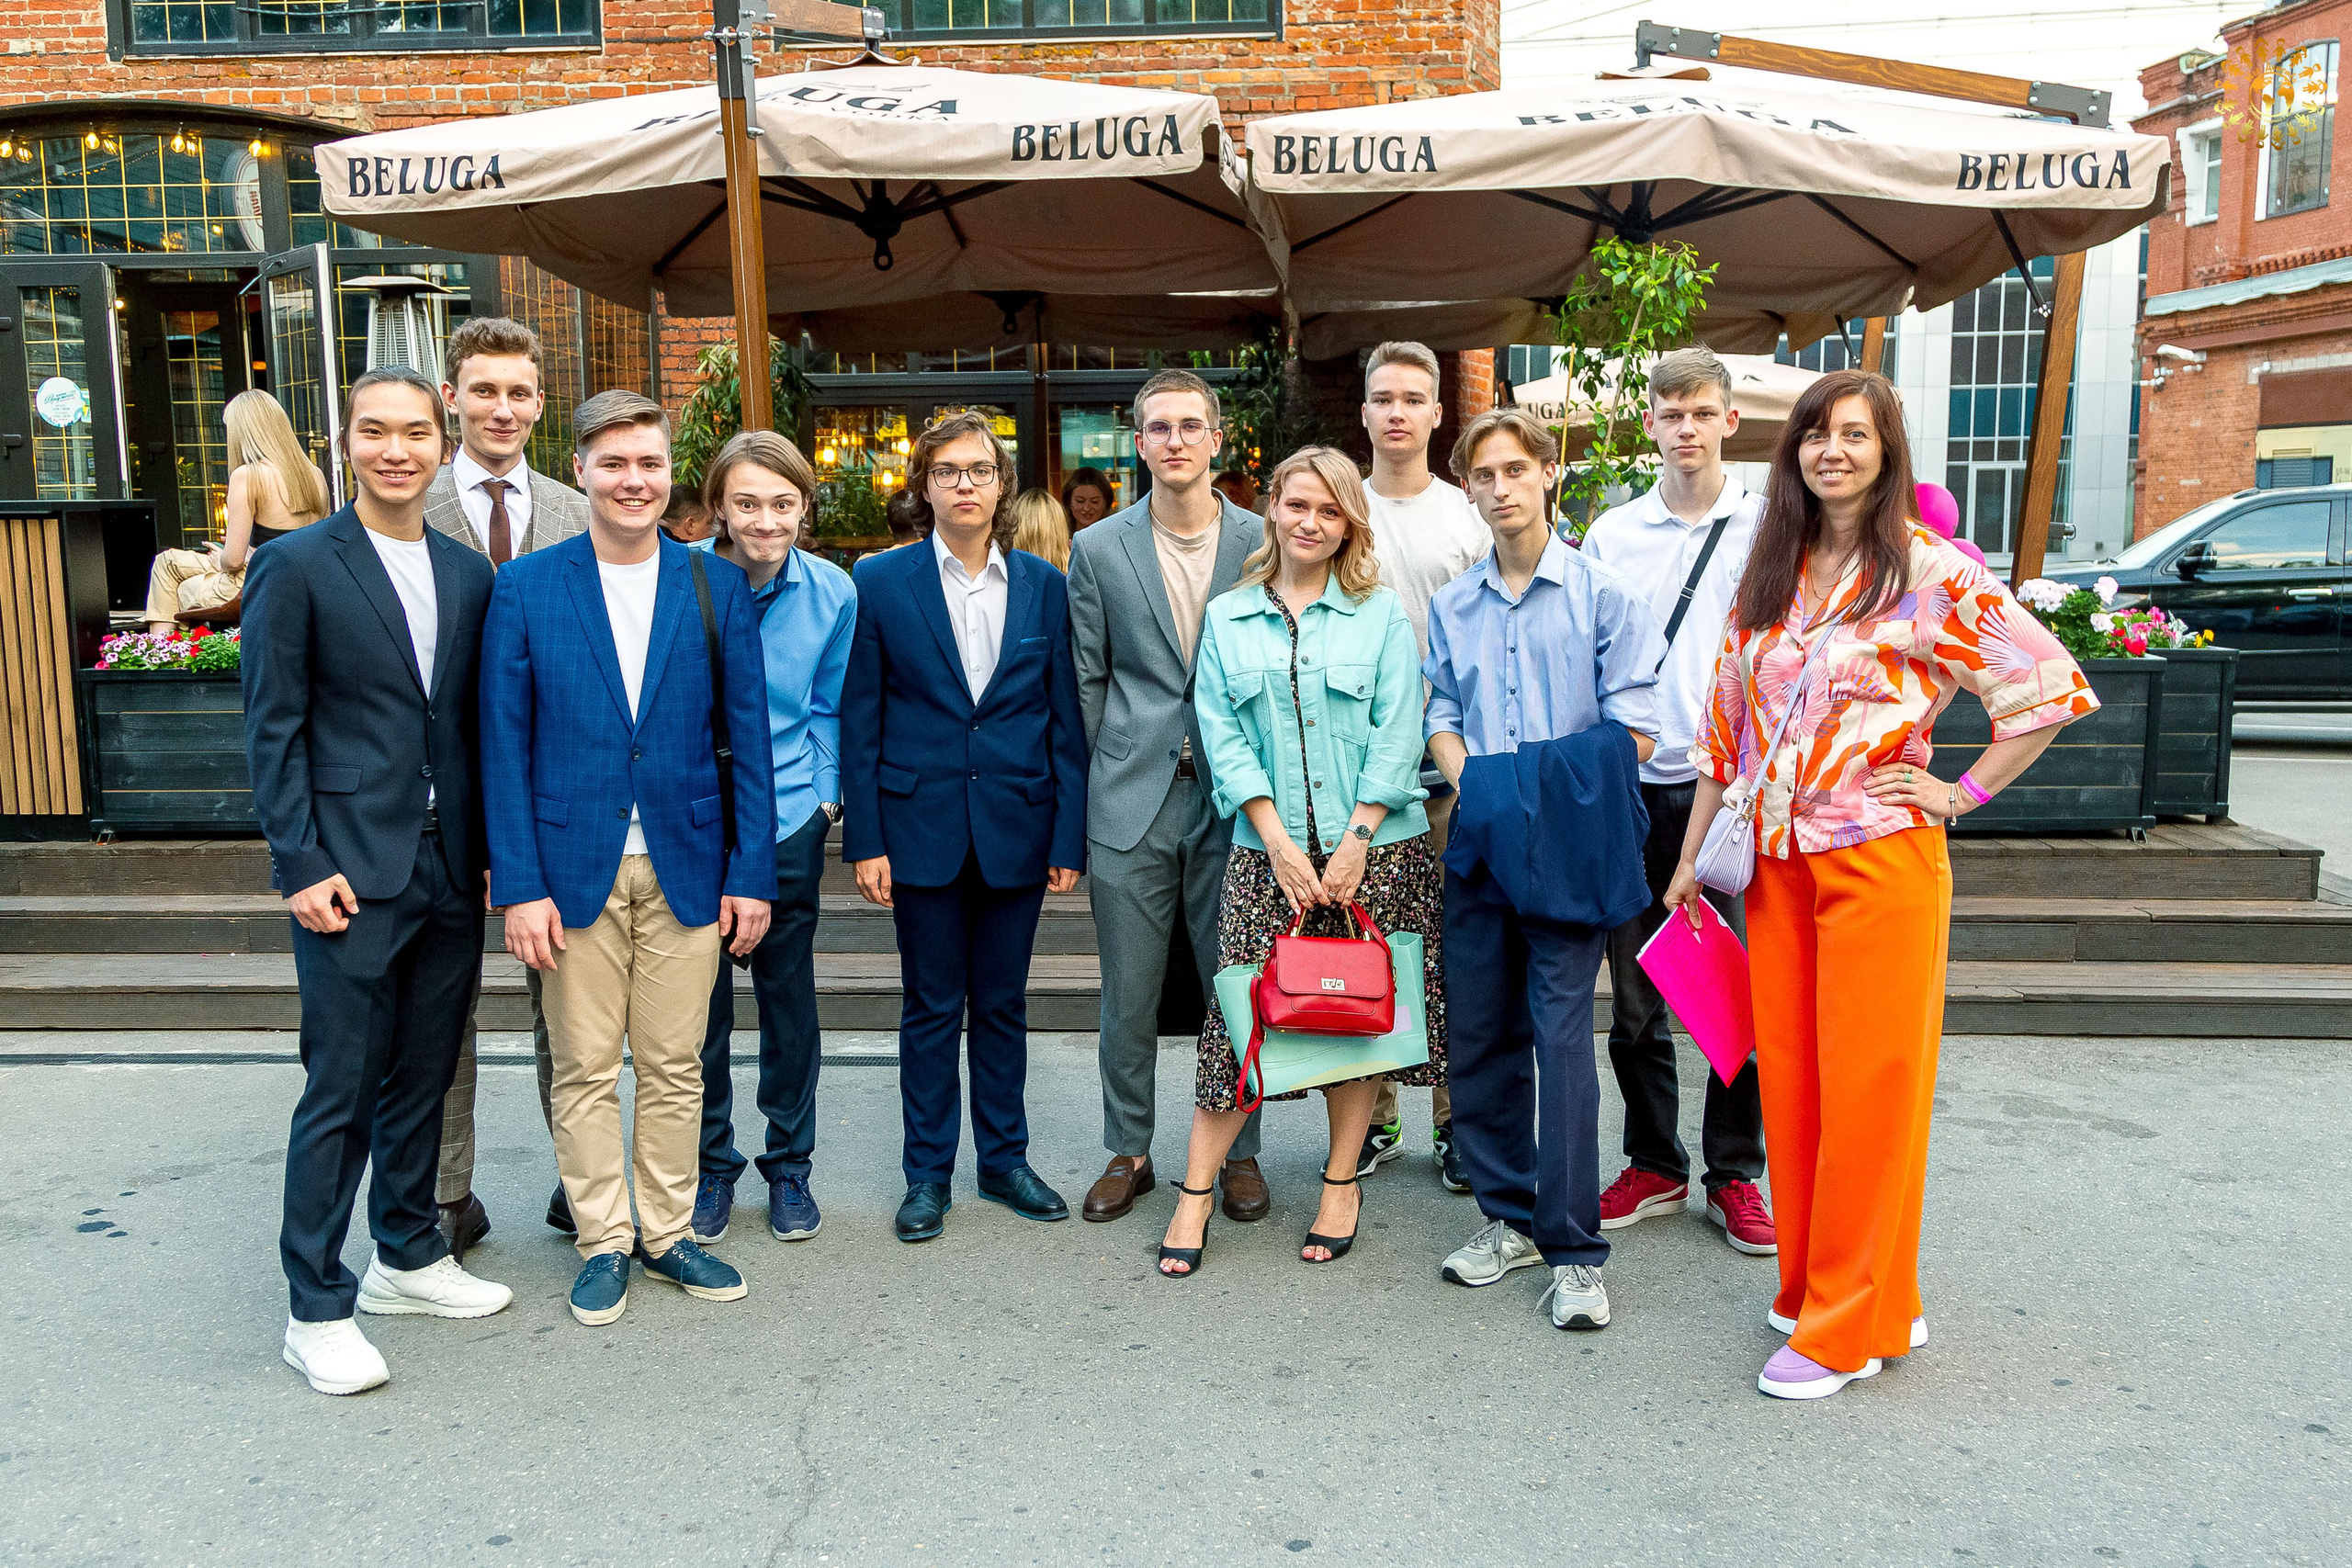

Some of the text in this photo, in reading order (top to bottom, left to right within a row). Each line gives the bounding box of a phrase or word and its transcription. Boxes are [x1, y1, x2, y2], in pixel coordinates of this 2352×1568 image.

[1010, 113, 1184, 162] BELUGA
[1272, 134, 1439, 175] BELUGA
[346, 153, 506, 197] BELUGA
[1955, 149, 2132, 191] BELUGA
